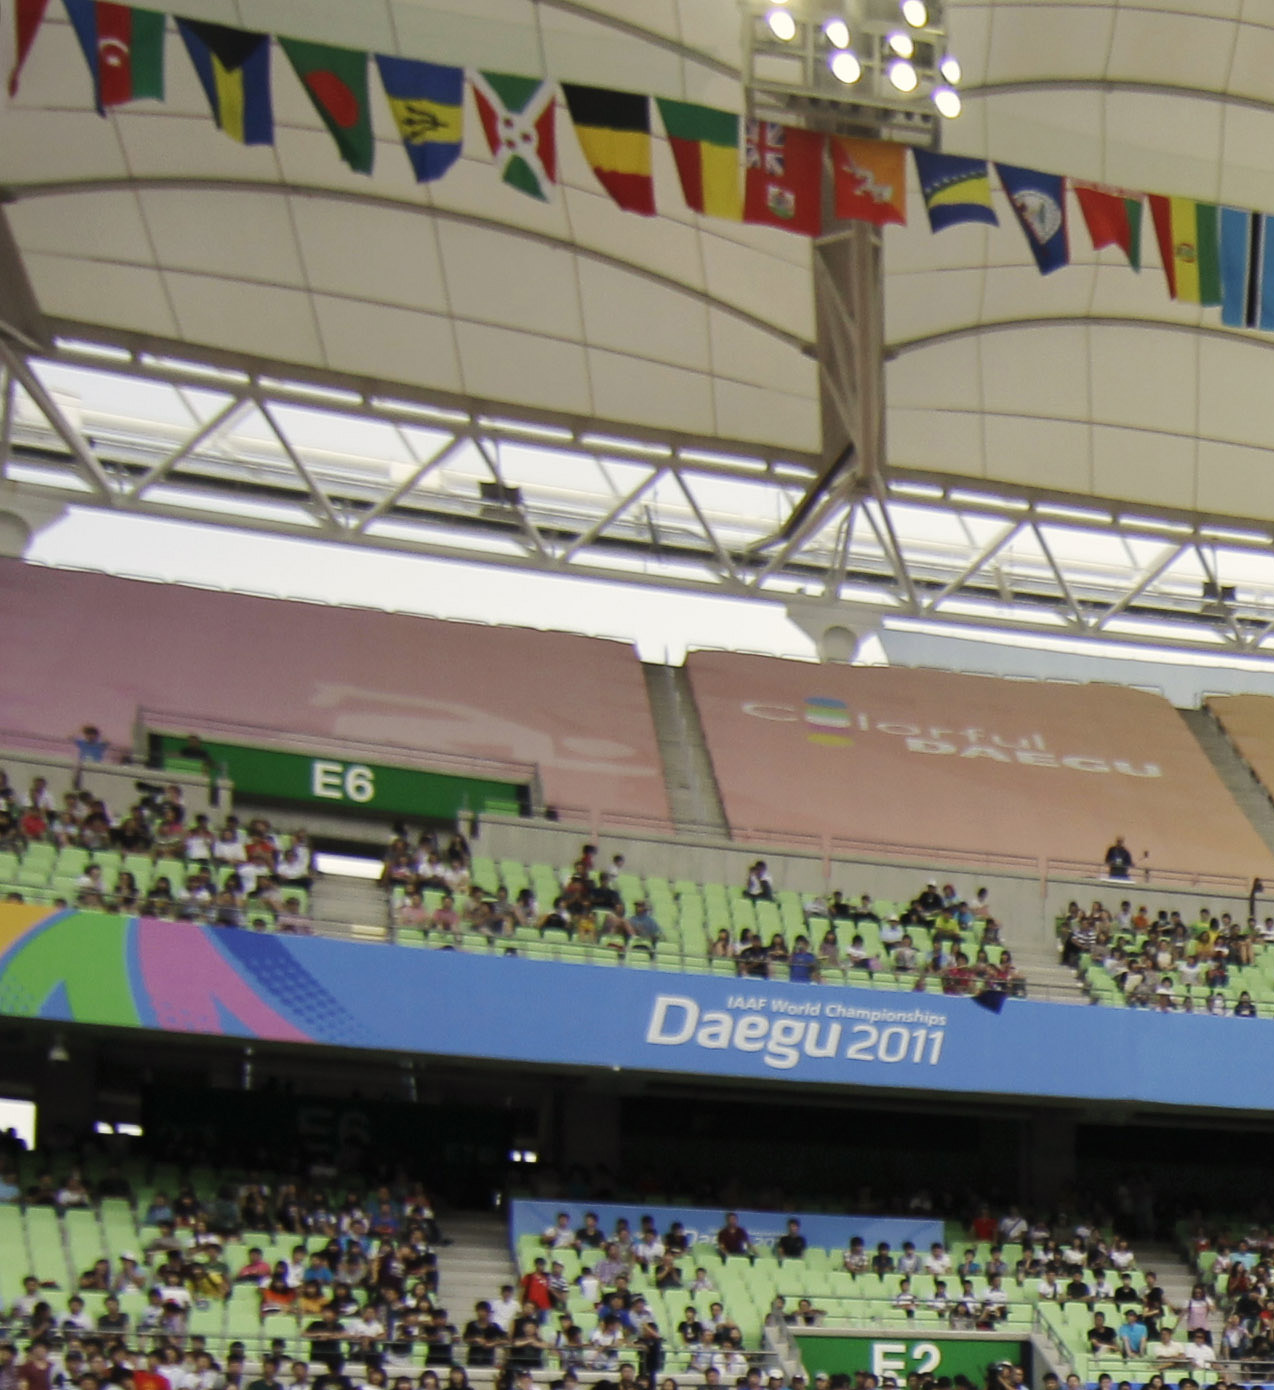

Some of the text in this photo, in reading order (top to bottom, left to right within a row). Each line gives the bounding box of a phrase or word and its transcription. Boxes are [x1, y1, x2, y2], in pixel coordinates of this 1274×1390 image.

[311, 760, 375, 803] E6
[646, 993, 945, 1069] Daegu 2011
[727, 996, 947, 1026] IAAF World Championships
[873, 1342, 941, 1388] E2
